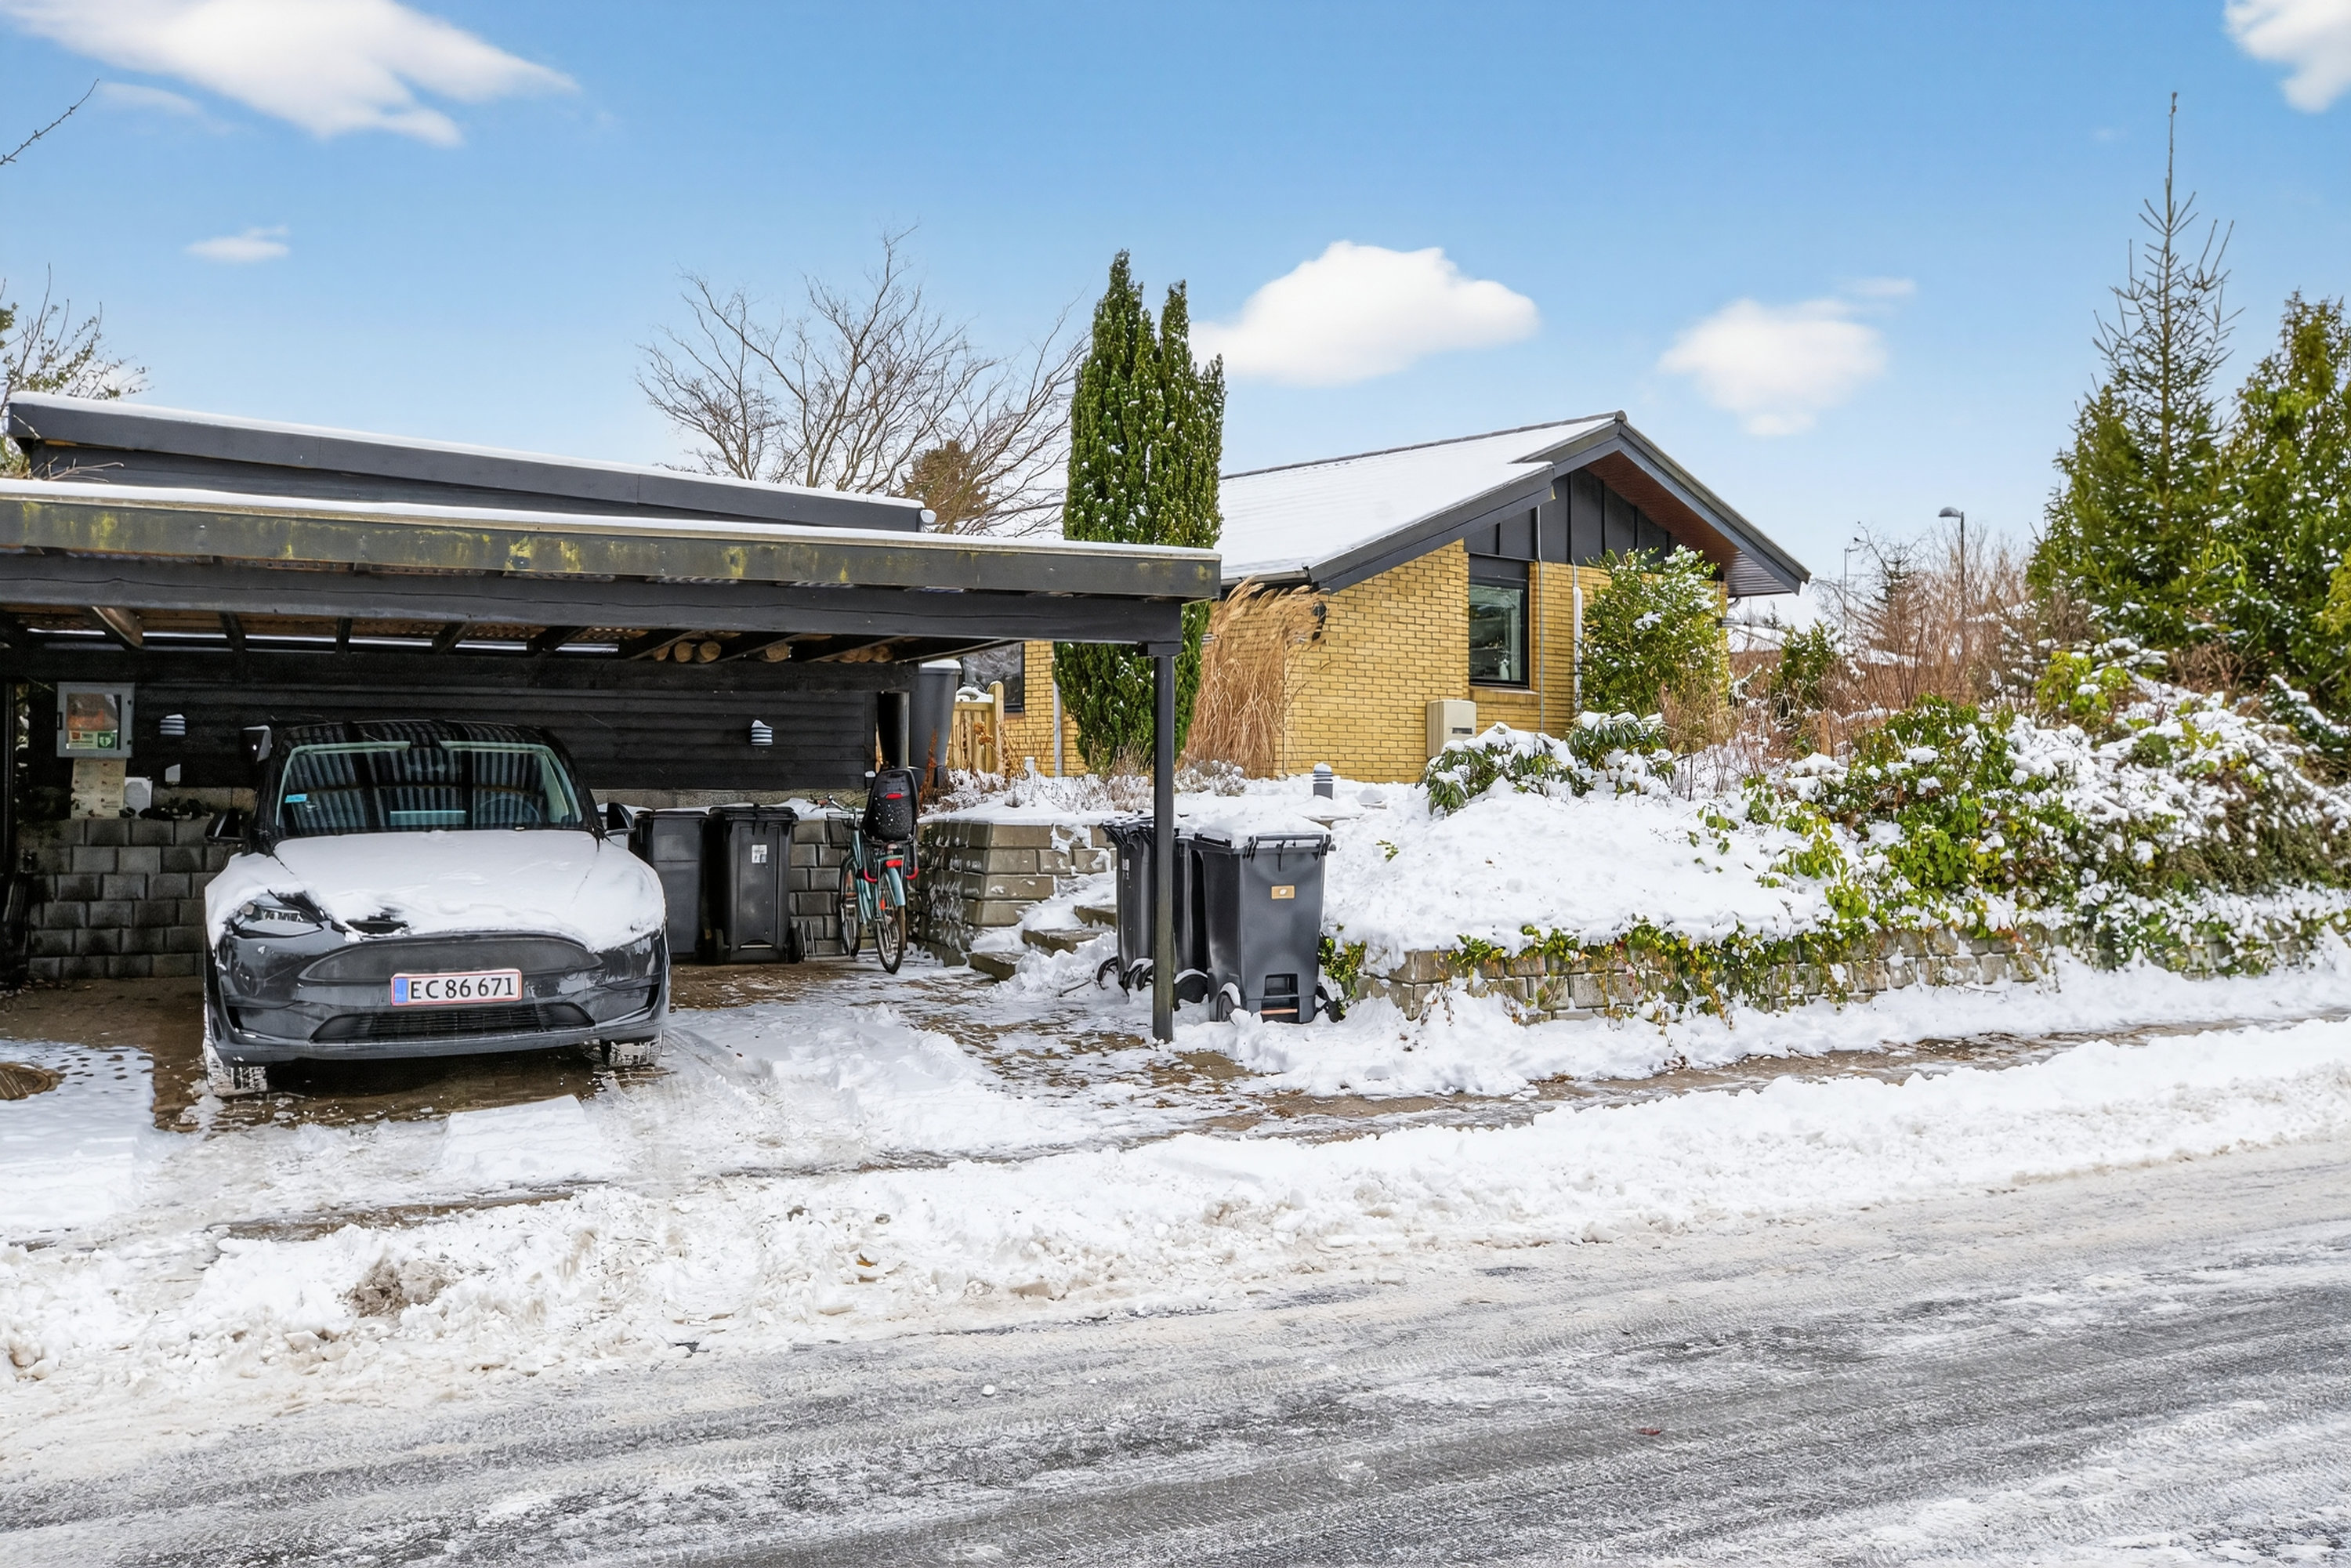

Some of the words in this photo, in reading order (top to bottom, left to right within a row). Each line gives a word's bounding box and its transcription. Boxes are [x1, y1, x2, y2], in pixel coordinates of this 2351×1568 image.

[411, 980, 439, 999] EC
[445, 979, 471, 999] 86
[477, 977, 514, 997] 671
